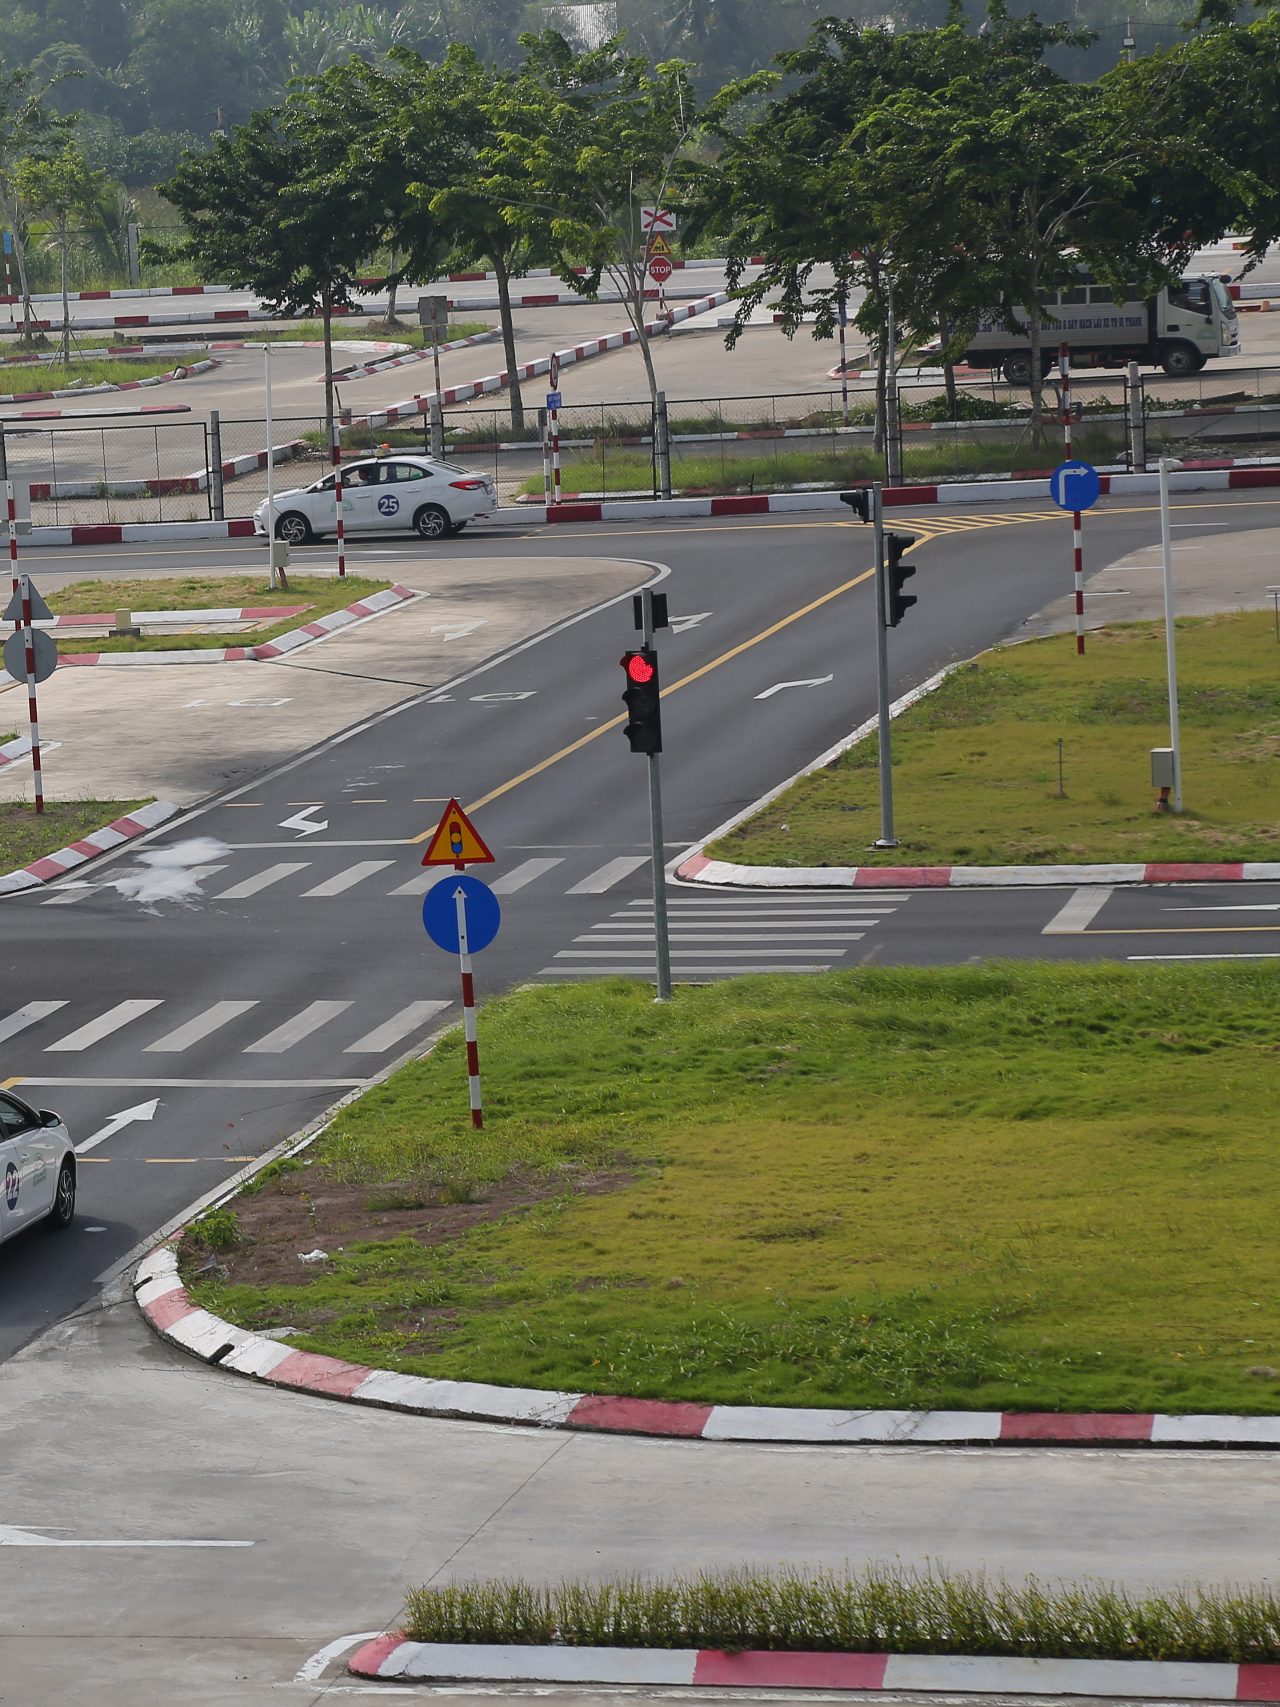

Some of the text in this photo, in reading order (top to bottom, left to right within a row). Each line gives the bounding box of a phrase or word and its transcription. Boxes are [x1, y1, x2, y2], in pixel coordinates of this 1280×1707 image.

[650, 266, 671, 274] STOP
[380, 498, 399, 513] 25
[7, 1170, 19, 1200] 22
